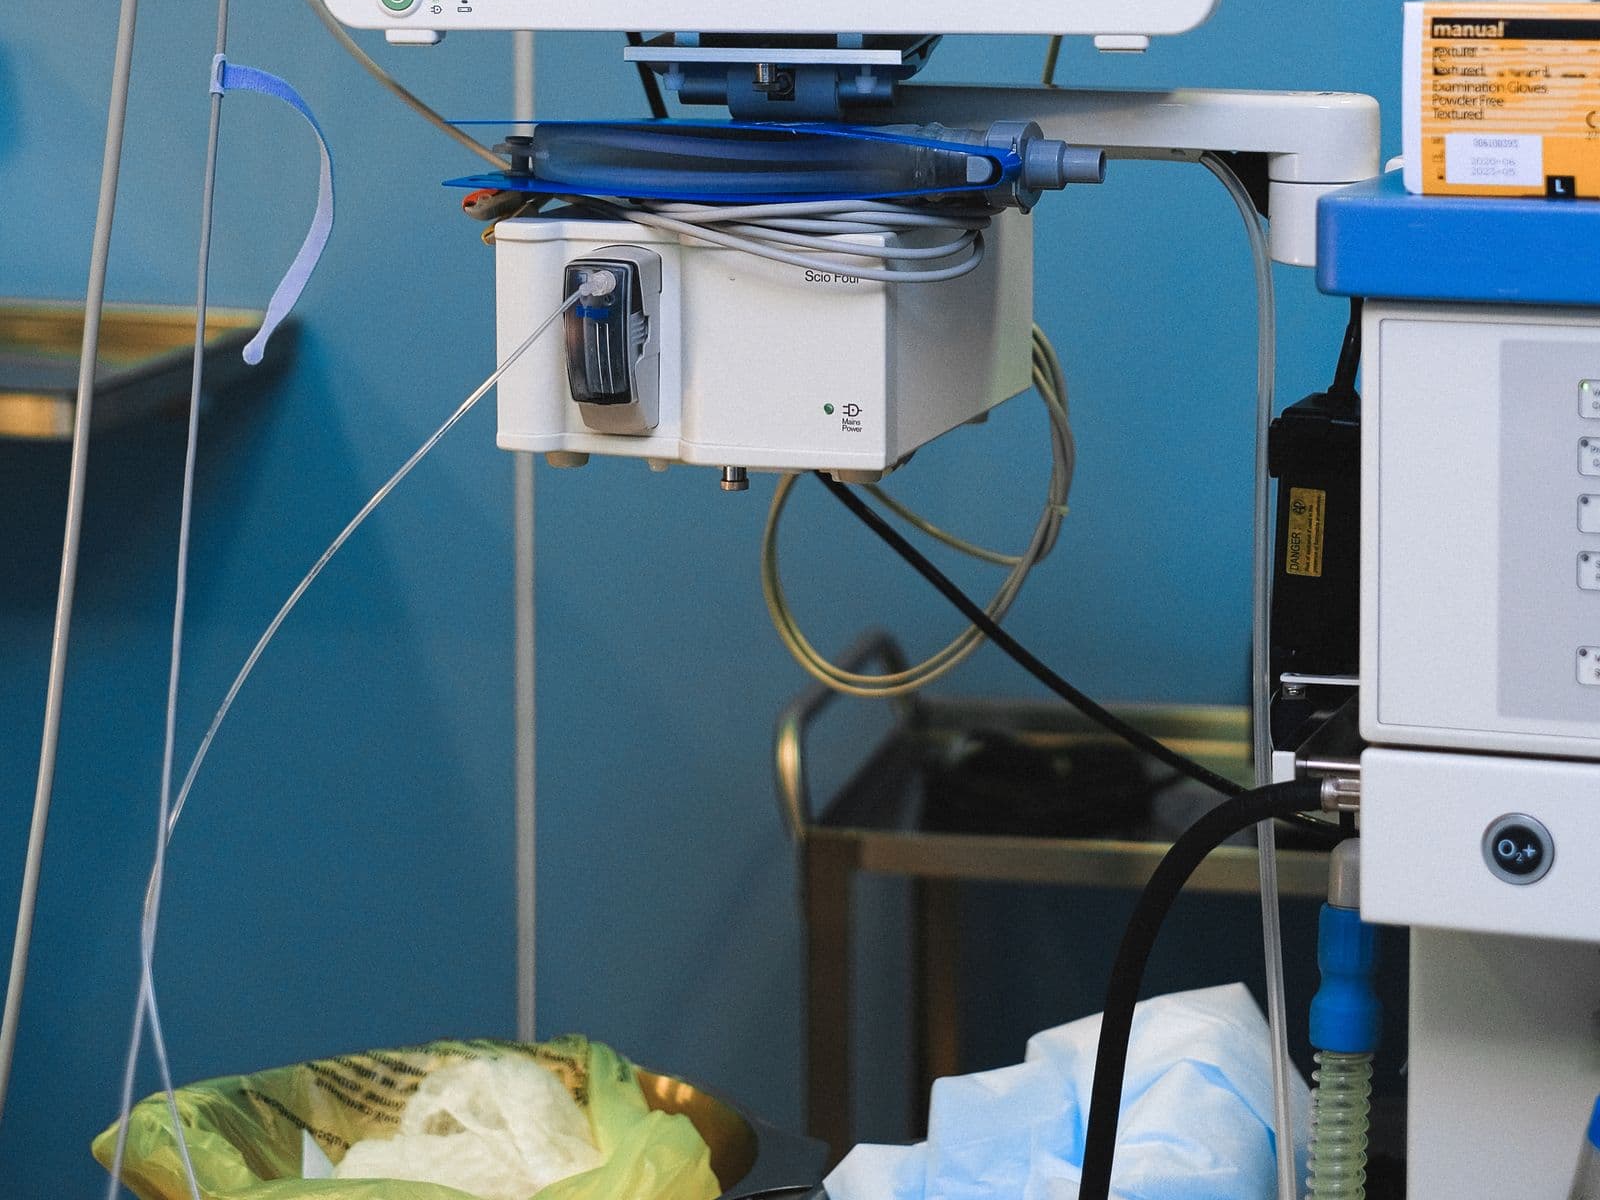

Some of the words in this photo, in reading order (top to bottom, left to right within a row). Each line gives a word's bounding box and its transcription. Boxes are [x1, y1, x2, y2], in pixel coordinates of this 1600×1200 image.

[1433, 20, 1505, 38] manual
[1432, 80, 1505, 93] Examination
[1431, 94, 1477, 106] Powder
[1479, 94, 1505, 107] Free
[1554, 178, 1565, 193] L
[804, 269, 831, 283] Scio
[841, 417, 861, 426] Mains
[841, 425, 862, 433] Power
